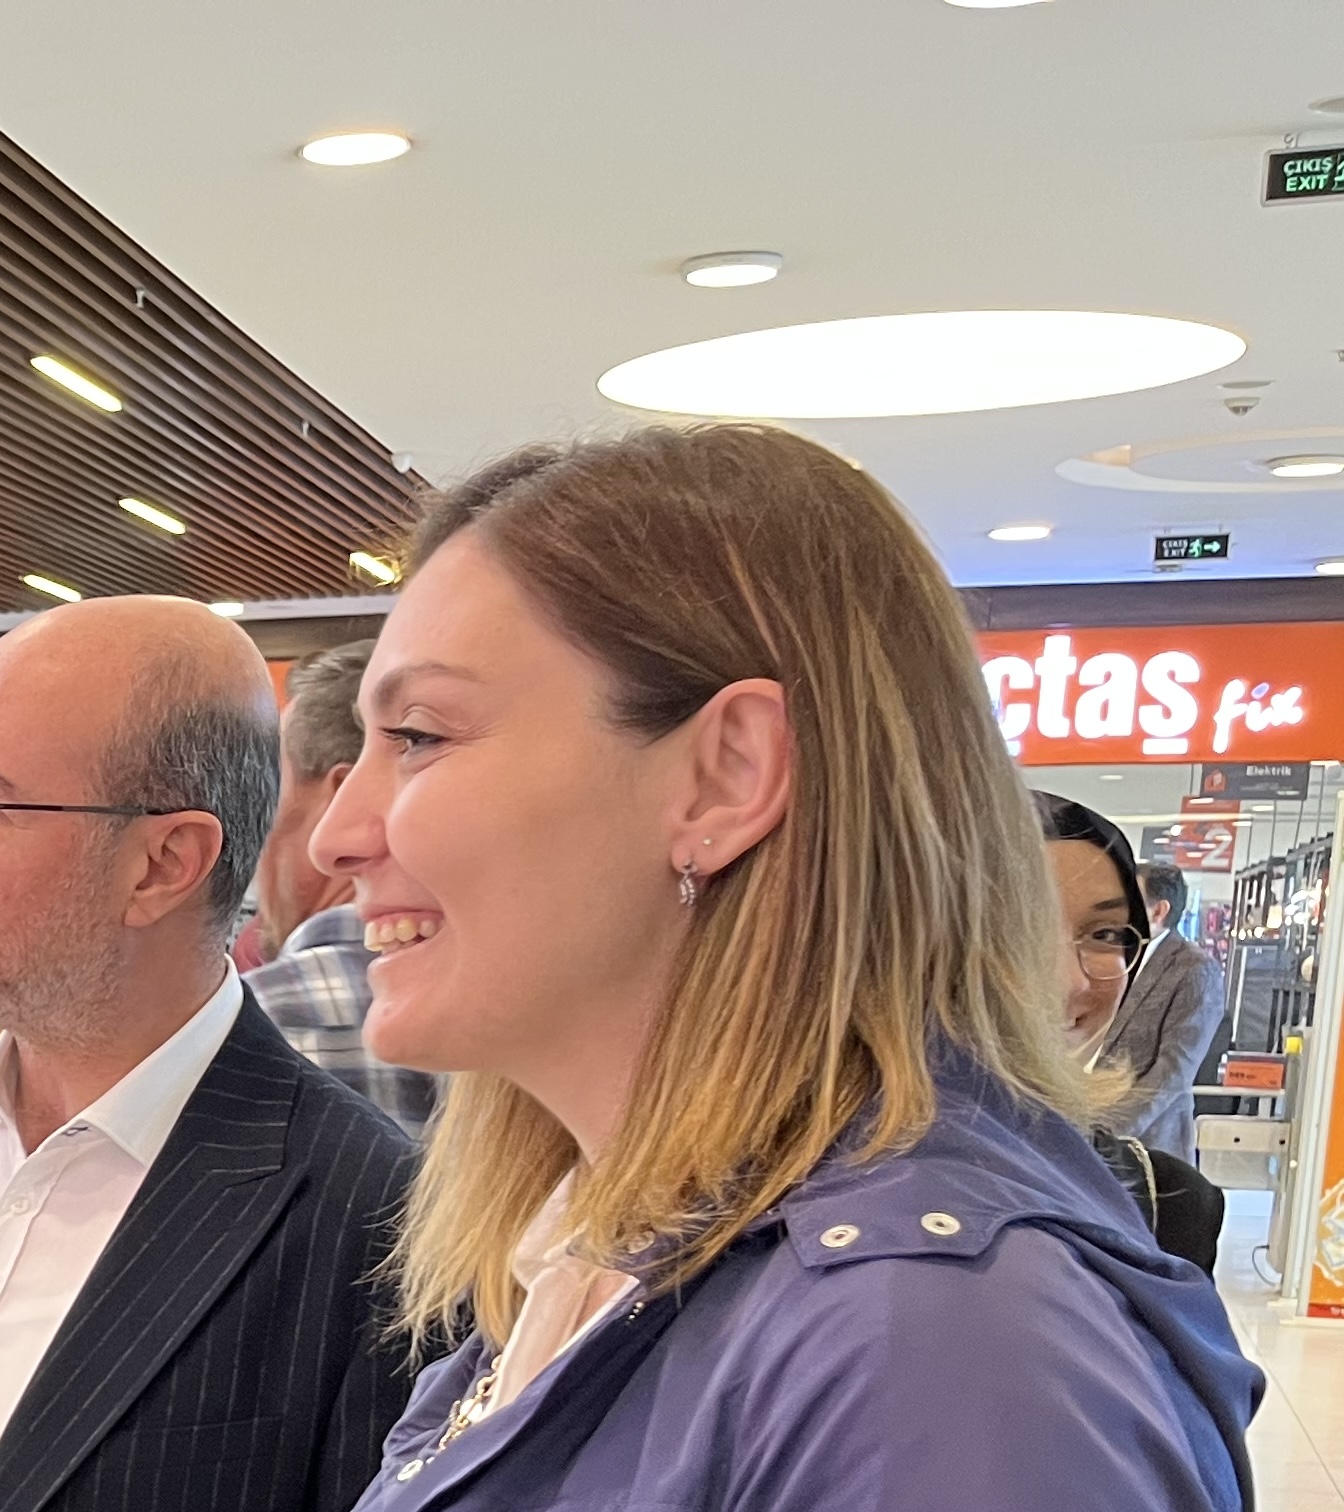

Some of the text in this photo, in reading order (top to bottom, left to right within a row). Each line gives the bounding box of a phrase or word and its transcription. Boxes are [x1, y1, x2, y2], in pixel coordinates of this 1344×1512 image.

[1283, 157, 1332, 176] ÇIKIŞ
[1286, 174, 1329, 192] EXIT
[1213, 678, 1304, 754] fix
